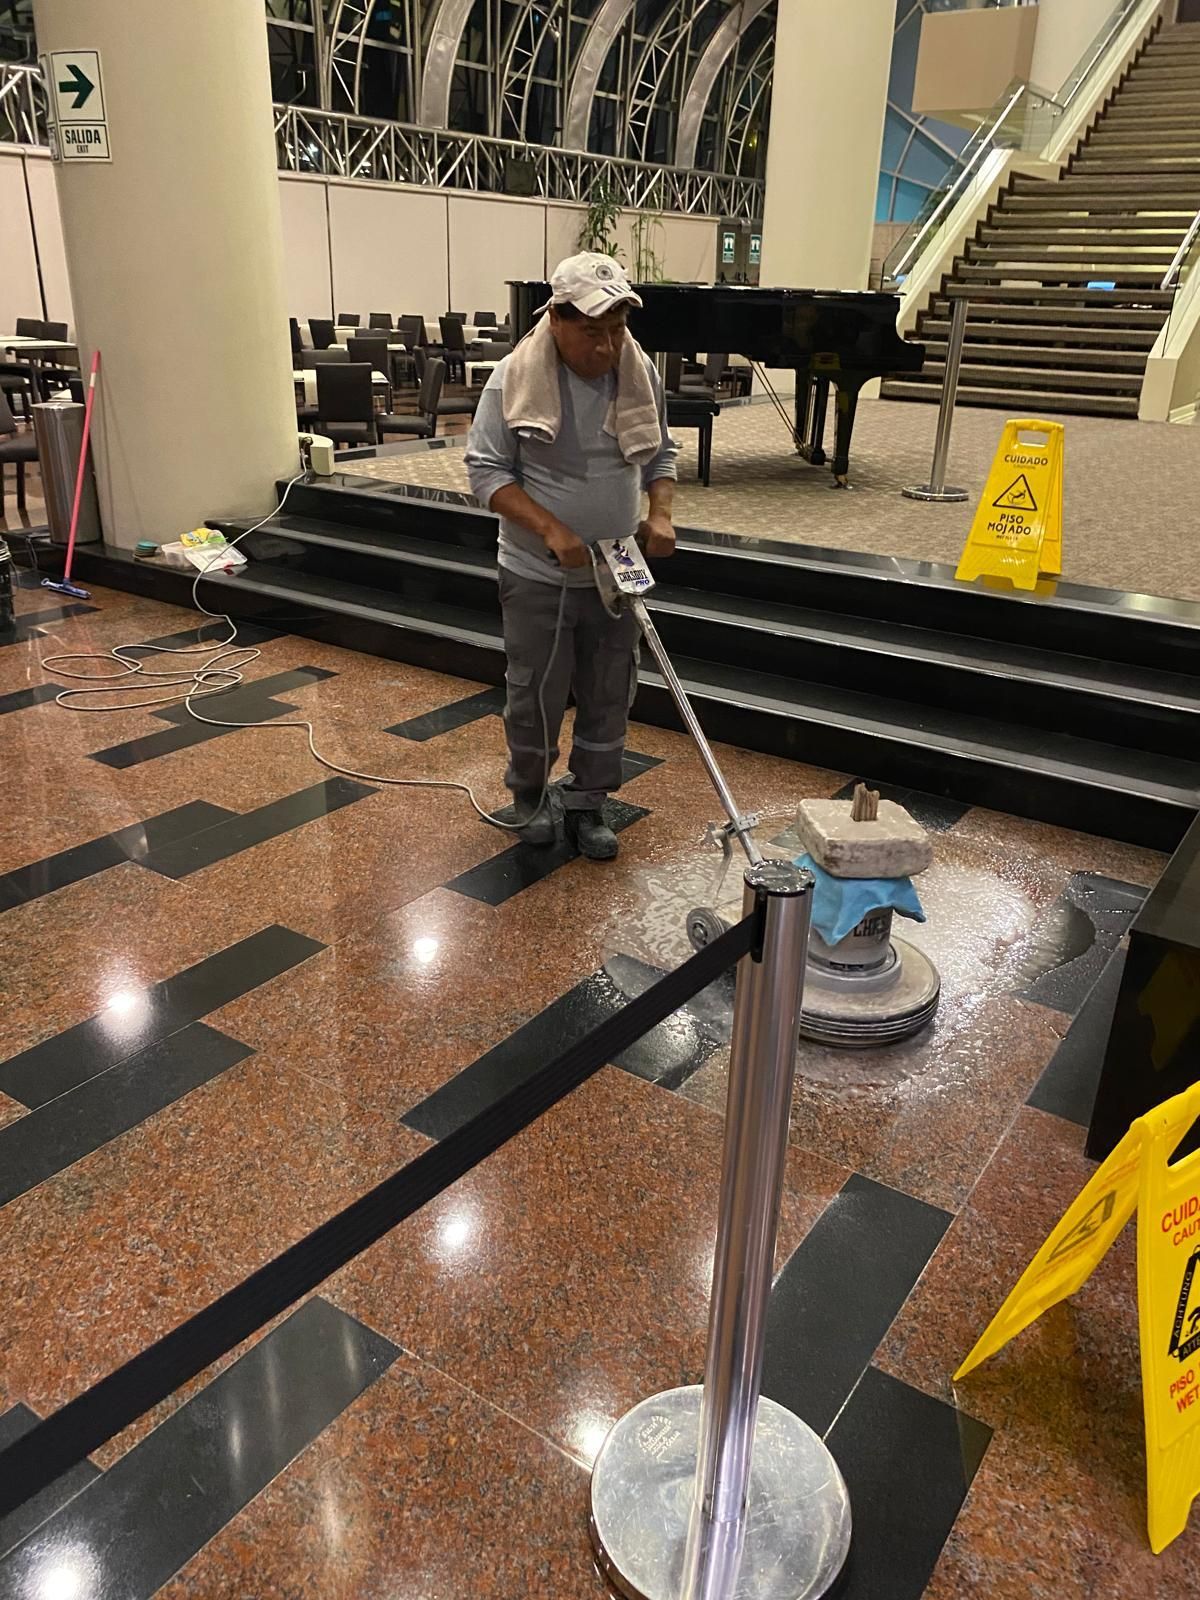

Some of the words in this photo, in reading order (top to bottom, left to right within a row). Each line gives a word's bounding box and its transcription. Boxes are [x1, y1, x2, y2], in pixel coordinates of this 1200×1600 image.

[65, 129, 101, 144] SALIDA
[76, 145, 88, 153] EXIT
[1004, 454, 1048, 466] CUIDADO
[1000, 513, 1024, 525] PISO
[987, 522, 1031, 535] MOJADO
[1161, 1196, 1200, 1232] CUID
[1174, 1271, 1193, 1338] ACHTUNG
[1169, 1369, 1194, 1399] PISO
[1177, 1384, 1200, 1413] WET
